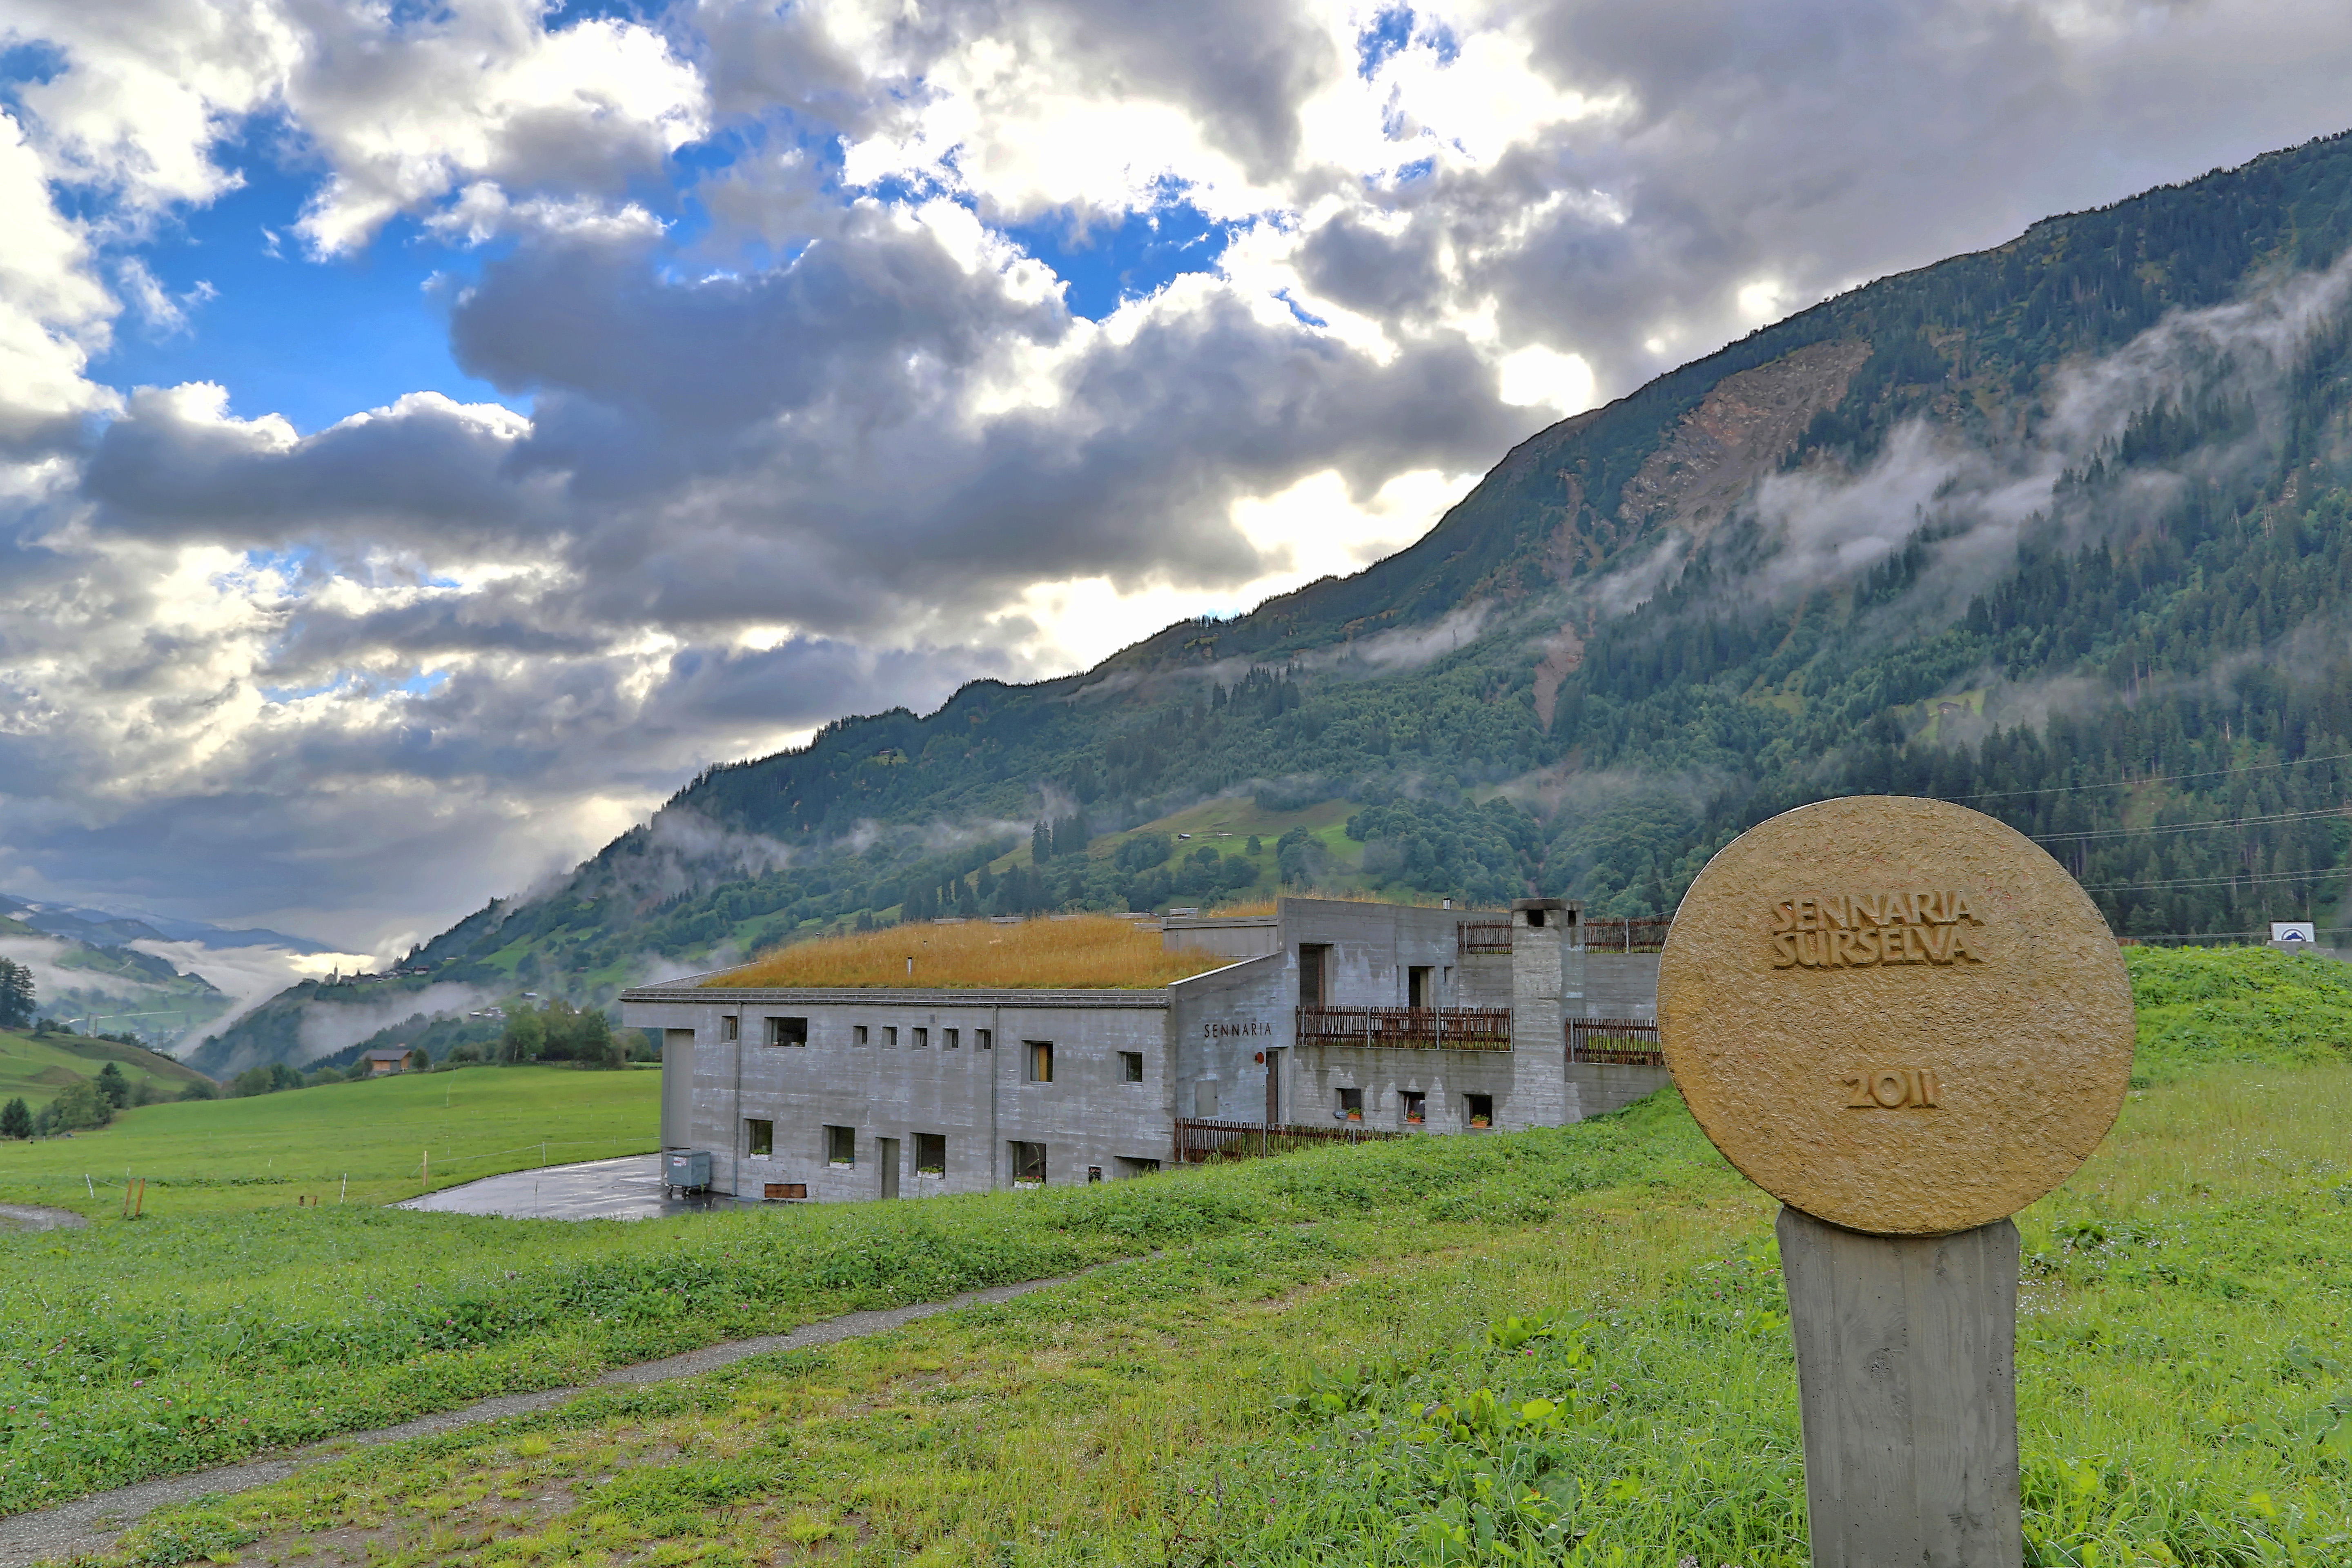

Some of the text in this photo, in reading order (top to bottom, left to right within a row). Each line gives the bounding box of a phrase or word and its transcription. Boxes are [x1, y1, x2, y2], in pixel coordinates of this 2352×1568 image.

[1771, 890, 1986, 934] SENNARIA
[1773, 926, 1984, 969] SURSELVA
[1204, 1023, 1272, 1038] SENNARIA
[1842, 1069, 1940, 1109] 2011
